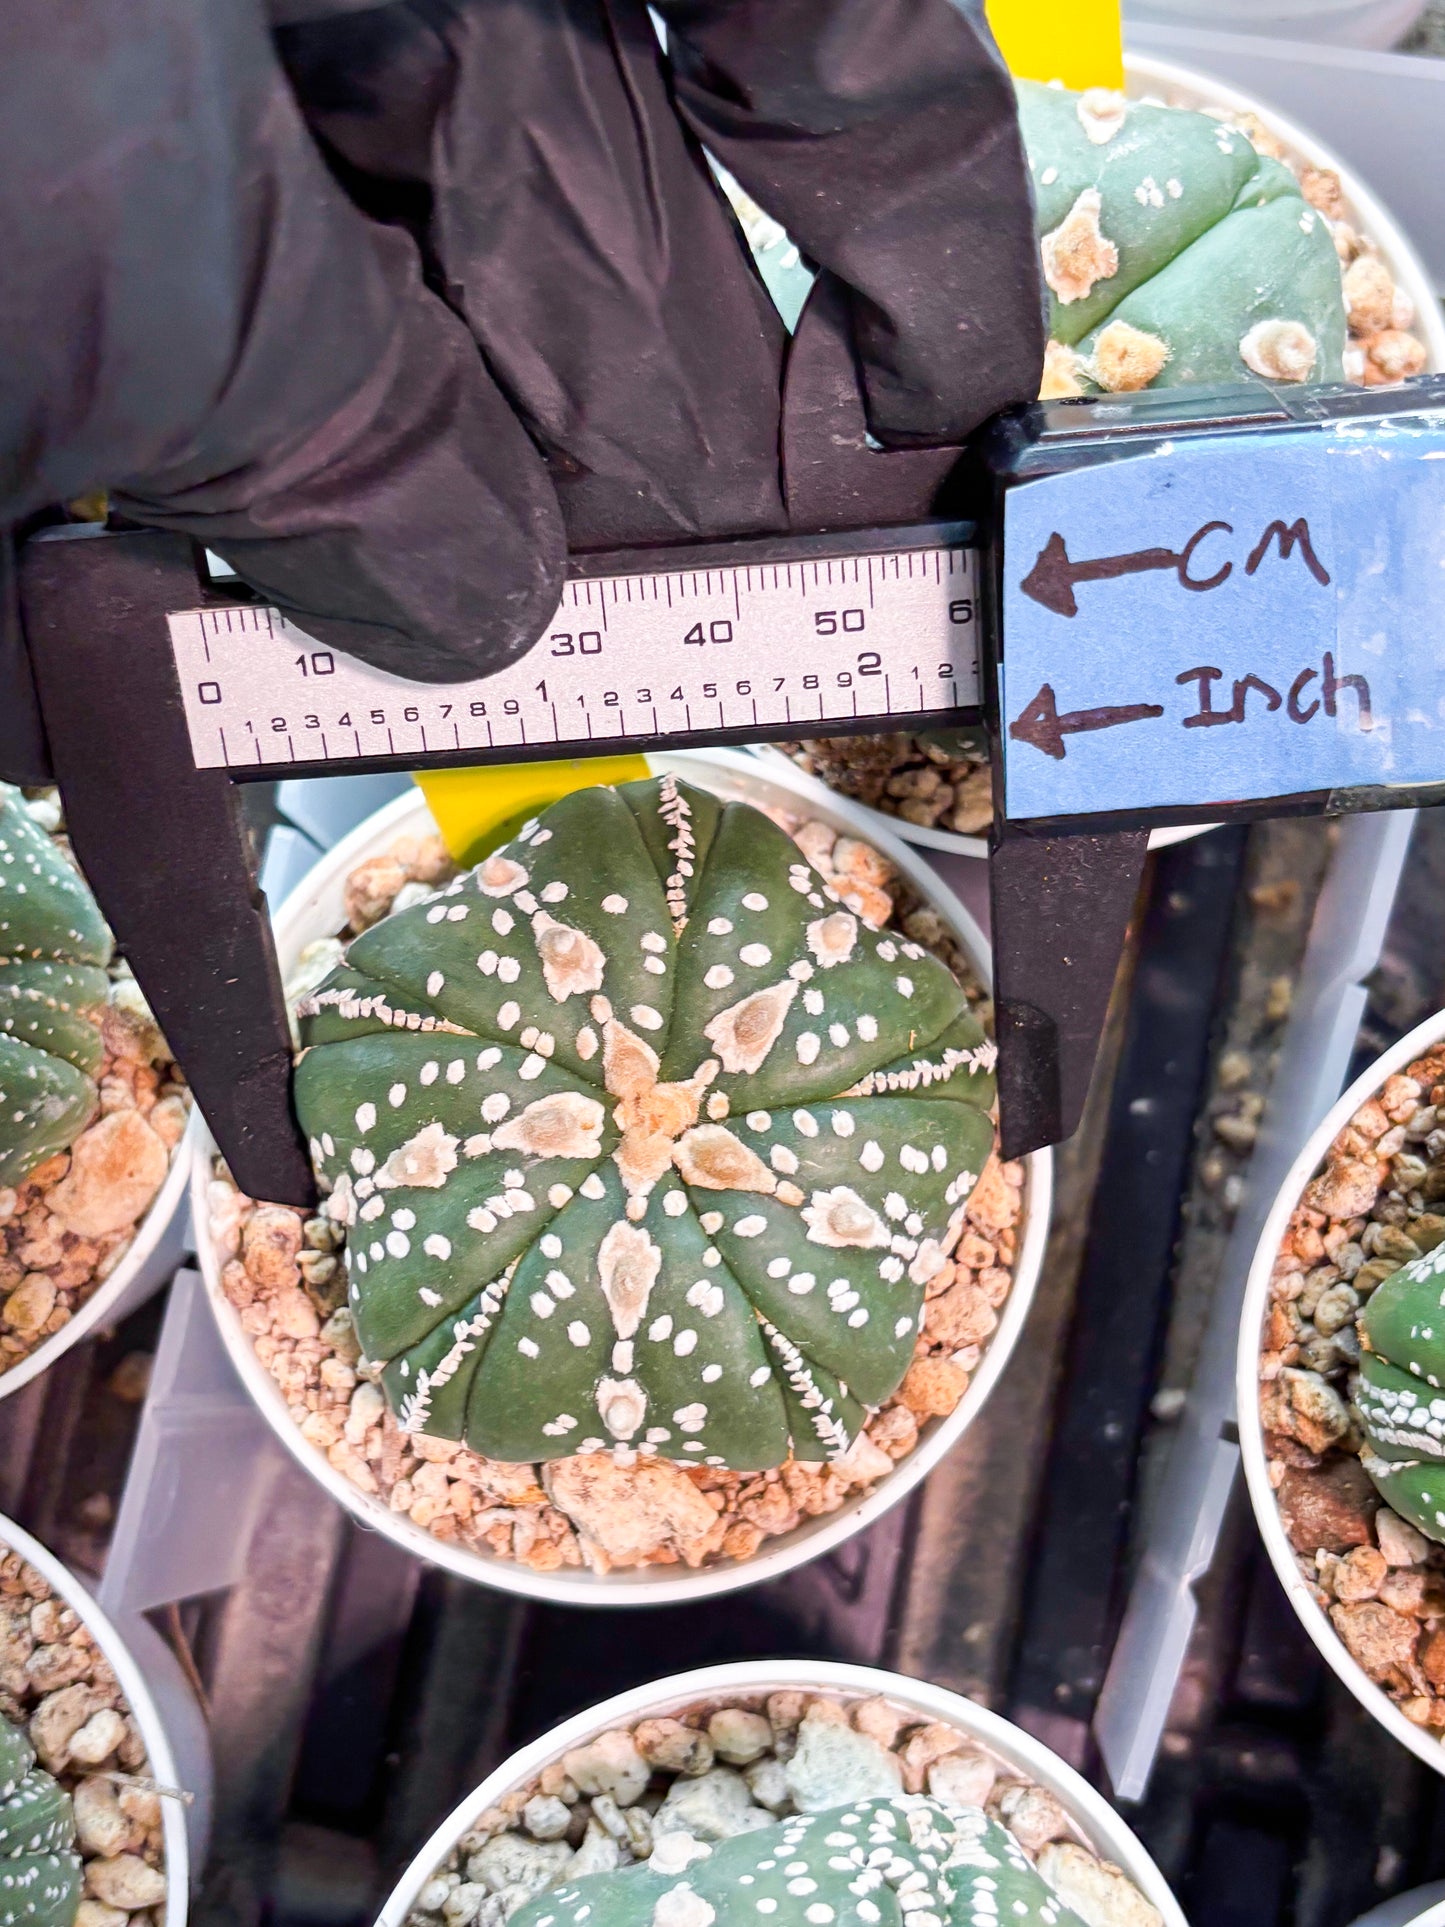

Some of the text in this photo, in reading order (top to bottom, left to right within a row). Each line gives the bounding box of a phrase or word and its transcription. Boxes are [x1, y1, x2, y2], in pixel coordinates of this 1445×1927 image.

[294, 651, 335, 677] 10
[550, 631, 602, 657] 30
[684, 620, 733, 647] 40
[814, 608, 866, 636] 50
[949, 598, 976, 625] 6
[245, 652, 953, 734] 1 2 3 4 5 6 7 8 9 1 1 2 3 4 5 6 7 8 9 2 1 2
[1175, 651, 1374, 732] Inch
